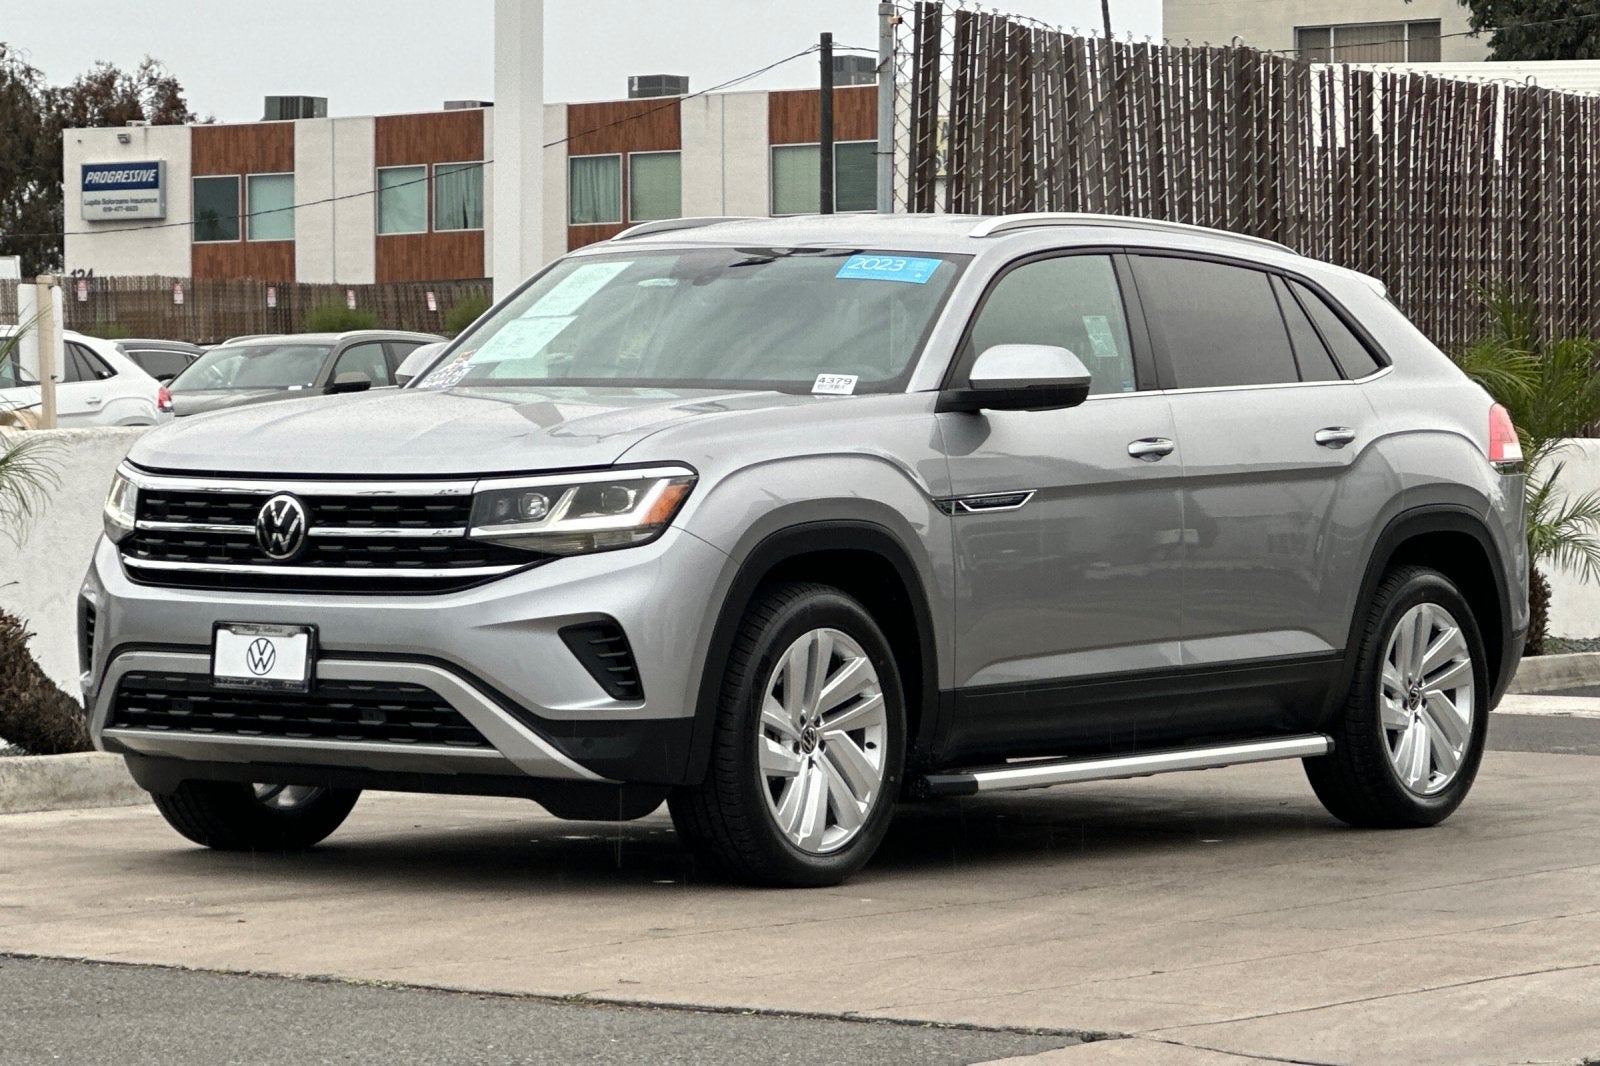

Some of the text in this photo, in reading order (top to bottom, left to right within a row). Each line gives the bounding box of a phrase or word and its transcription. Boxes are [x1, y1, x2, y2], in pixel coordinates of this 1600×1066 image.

[85, 169, 157, 184] PROGRESSIVE
[848, 257, 906, 271] 2023
[818, 377, 853, 385] 4379
